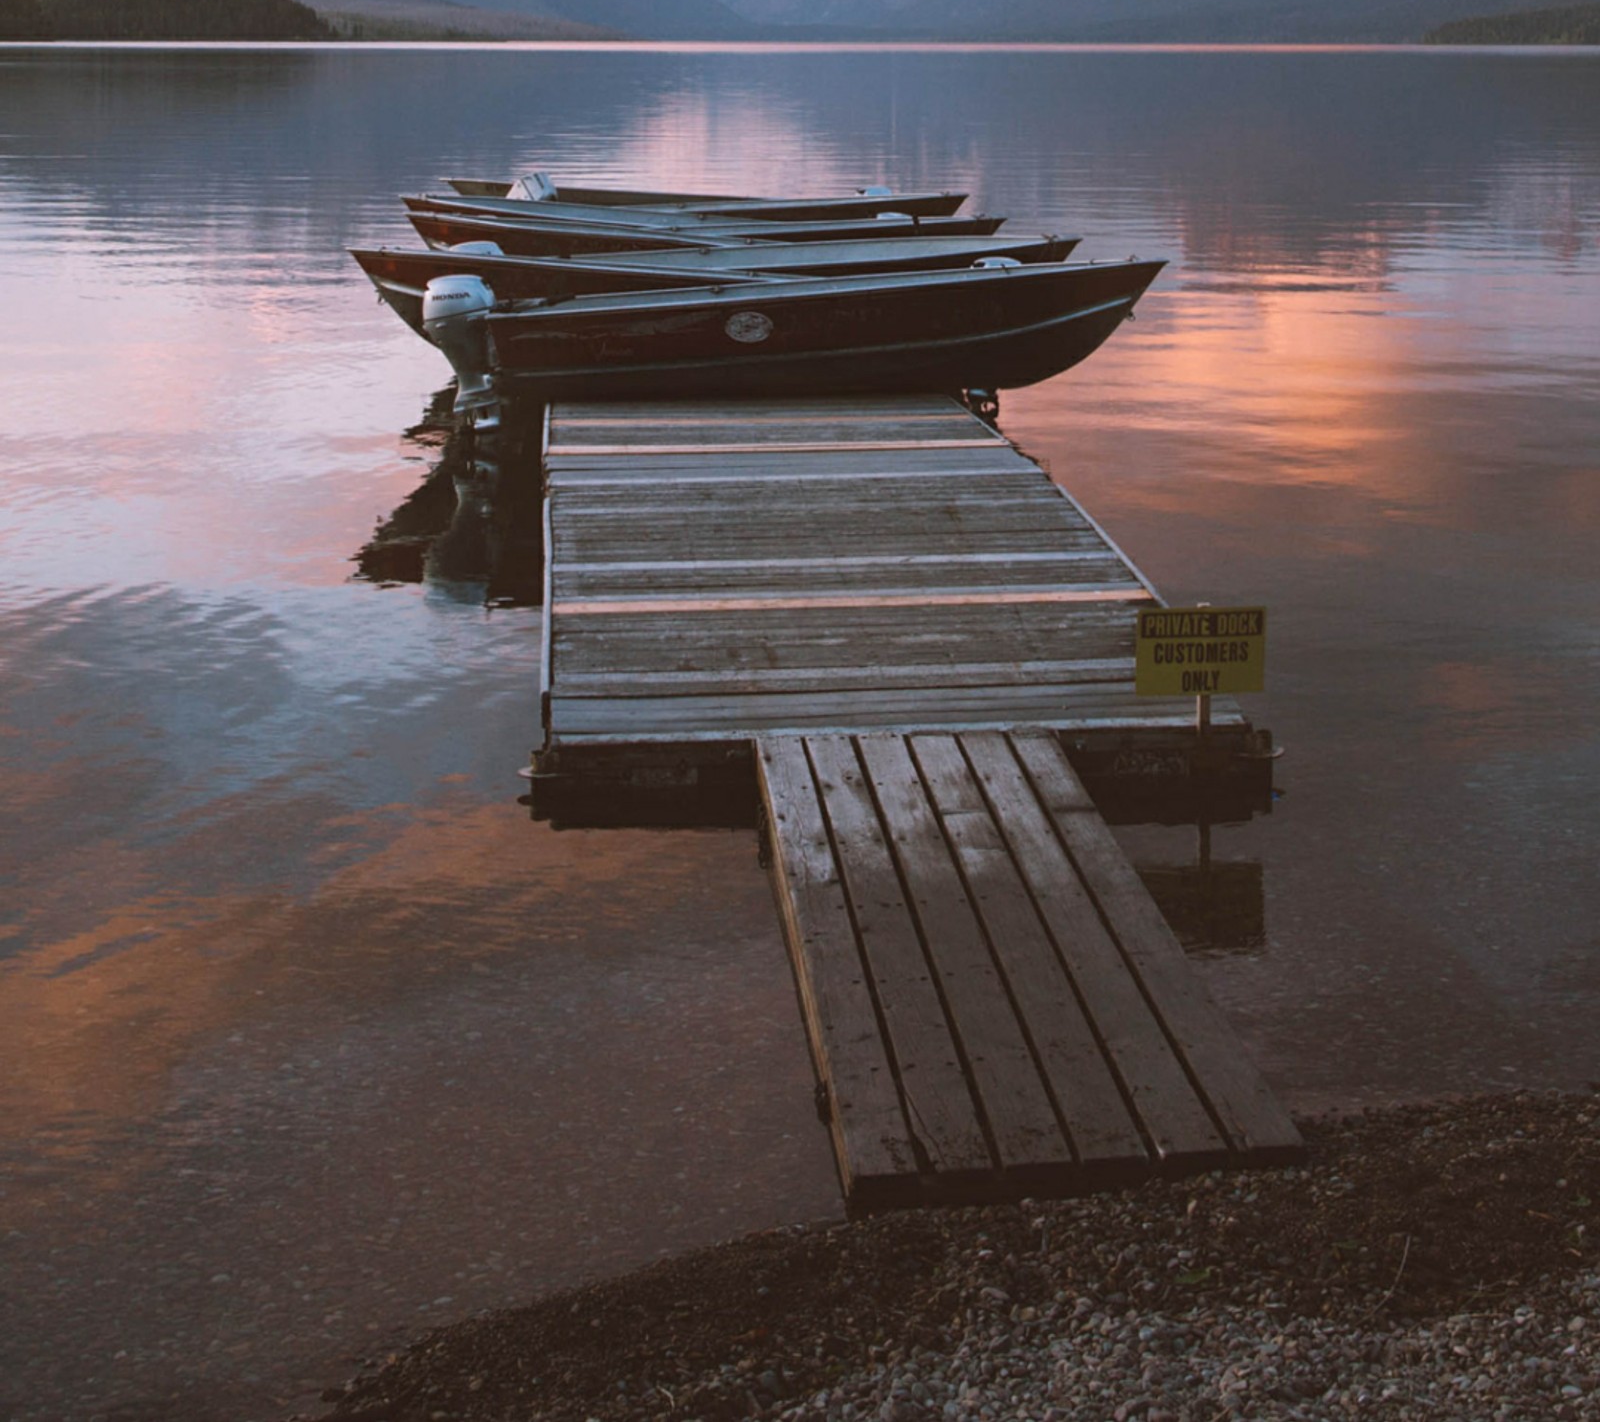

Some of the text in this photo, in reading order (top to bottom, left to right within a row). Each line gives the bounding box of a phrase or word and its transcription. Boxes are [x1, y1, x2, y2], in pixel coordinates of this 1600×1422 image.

[432, 292, 470, 301] HONDA
[1146, 612, 1257, 636] PRIVATE DOCK
[1154, 642, 1248, 664] CUSTOMERS
[1182, 670, 1219, 692] ONLY
